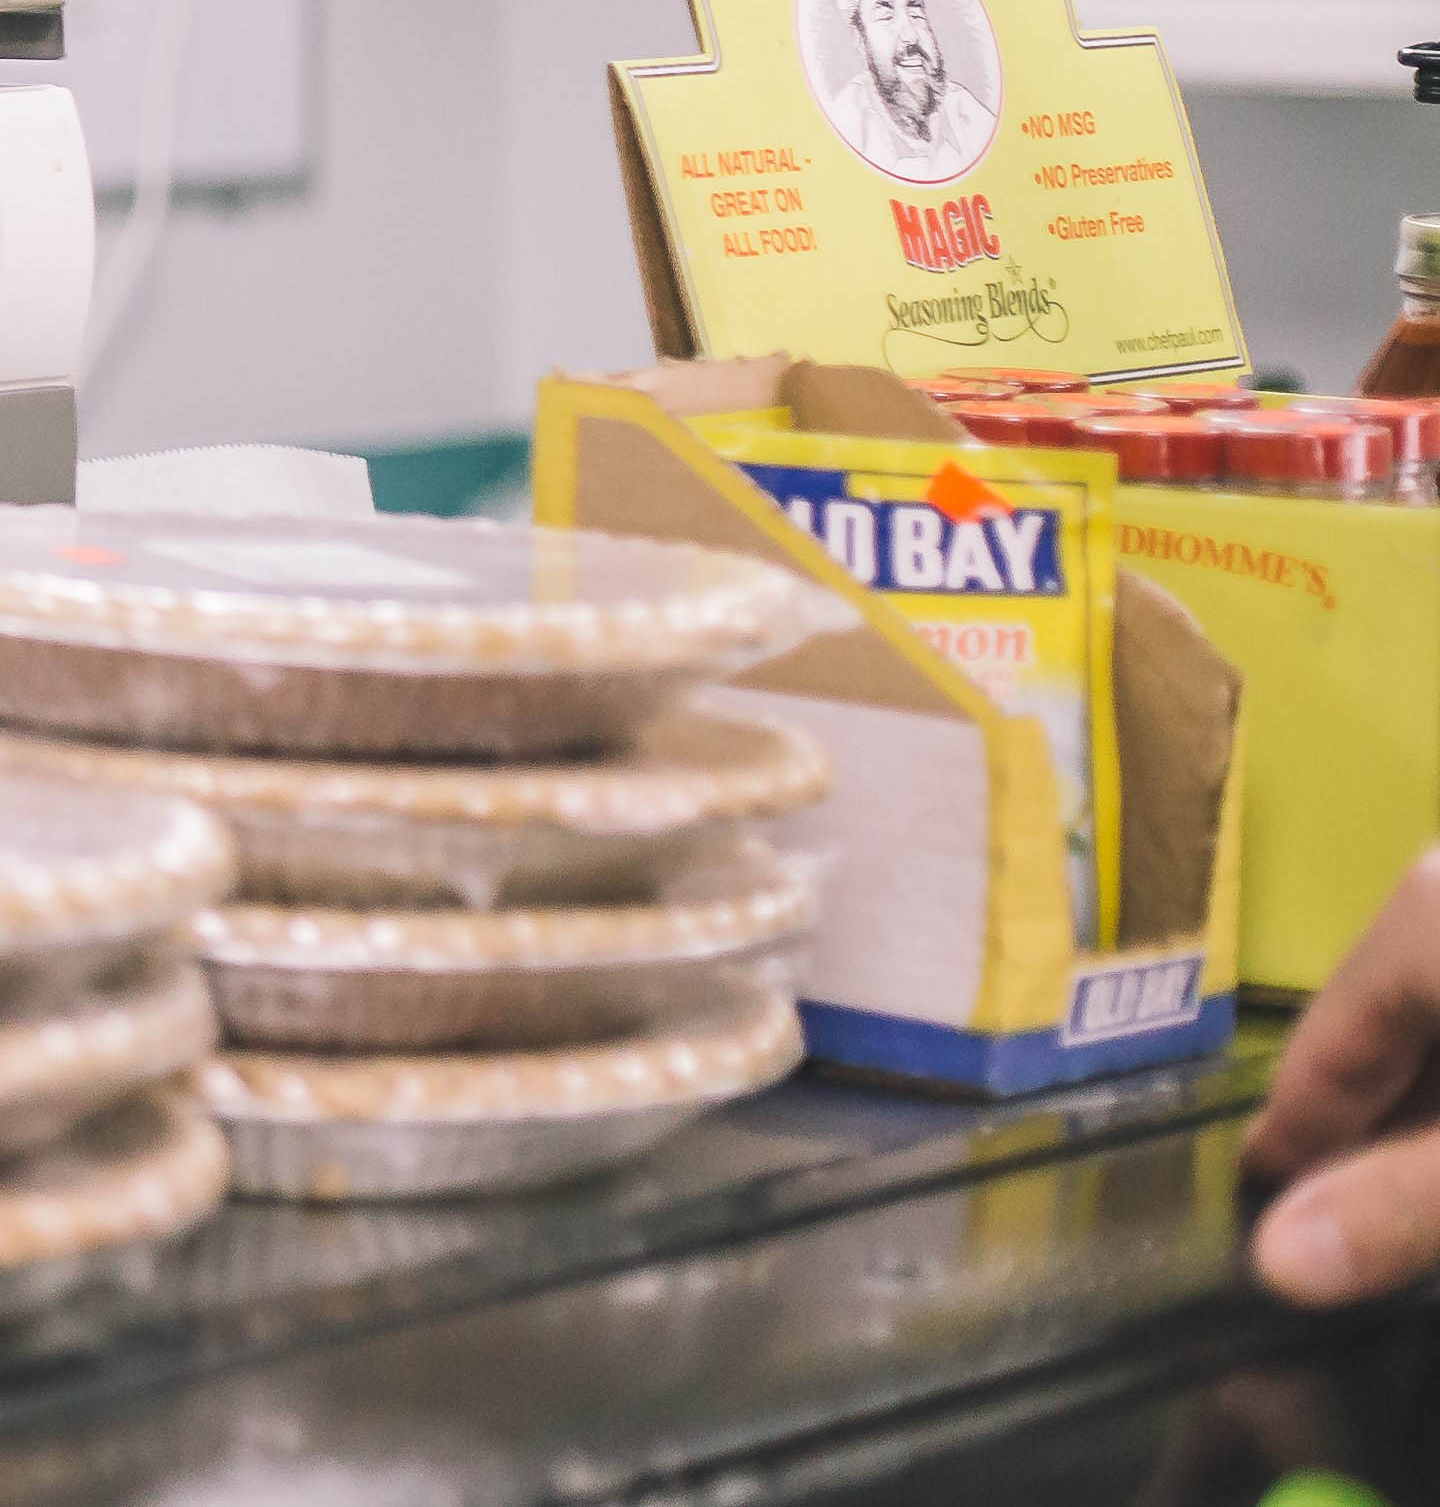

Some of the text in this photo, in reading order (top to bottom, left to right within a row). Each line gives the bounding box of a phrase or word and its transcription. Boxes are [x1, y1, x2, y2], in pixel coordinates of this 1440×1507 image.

[1029, 111, 1096, 139] NO MSG
[681, 153, 715, 179] ALL
[717, 147, 801, 177] NATURAL
[1041, 157, 1174, 189] NO Preservatives
[709, 187, 803, 219] GREAT ON
[722, 226, 818, 258] ALL FOOD!
[888, 193, 1001, 274] MAGIC
[1055, 211, 1145, 241] Gluten Free
[886, 277, 1058, 336] Seasoning Blends
[1114, 326, 1225, 354] www.chefpaul.com
[890, 504, 1046, 590] BAY
